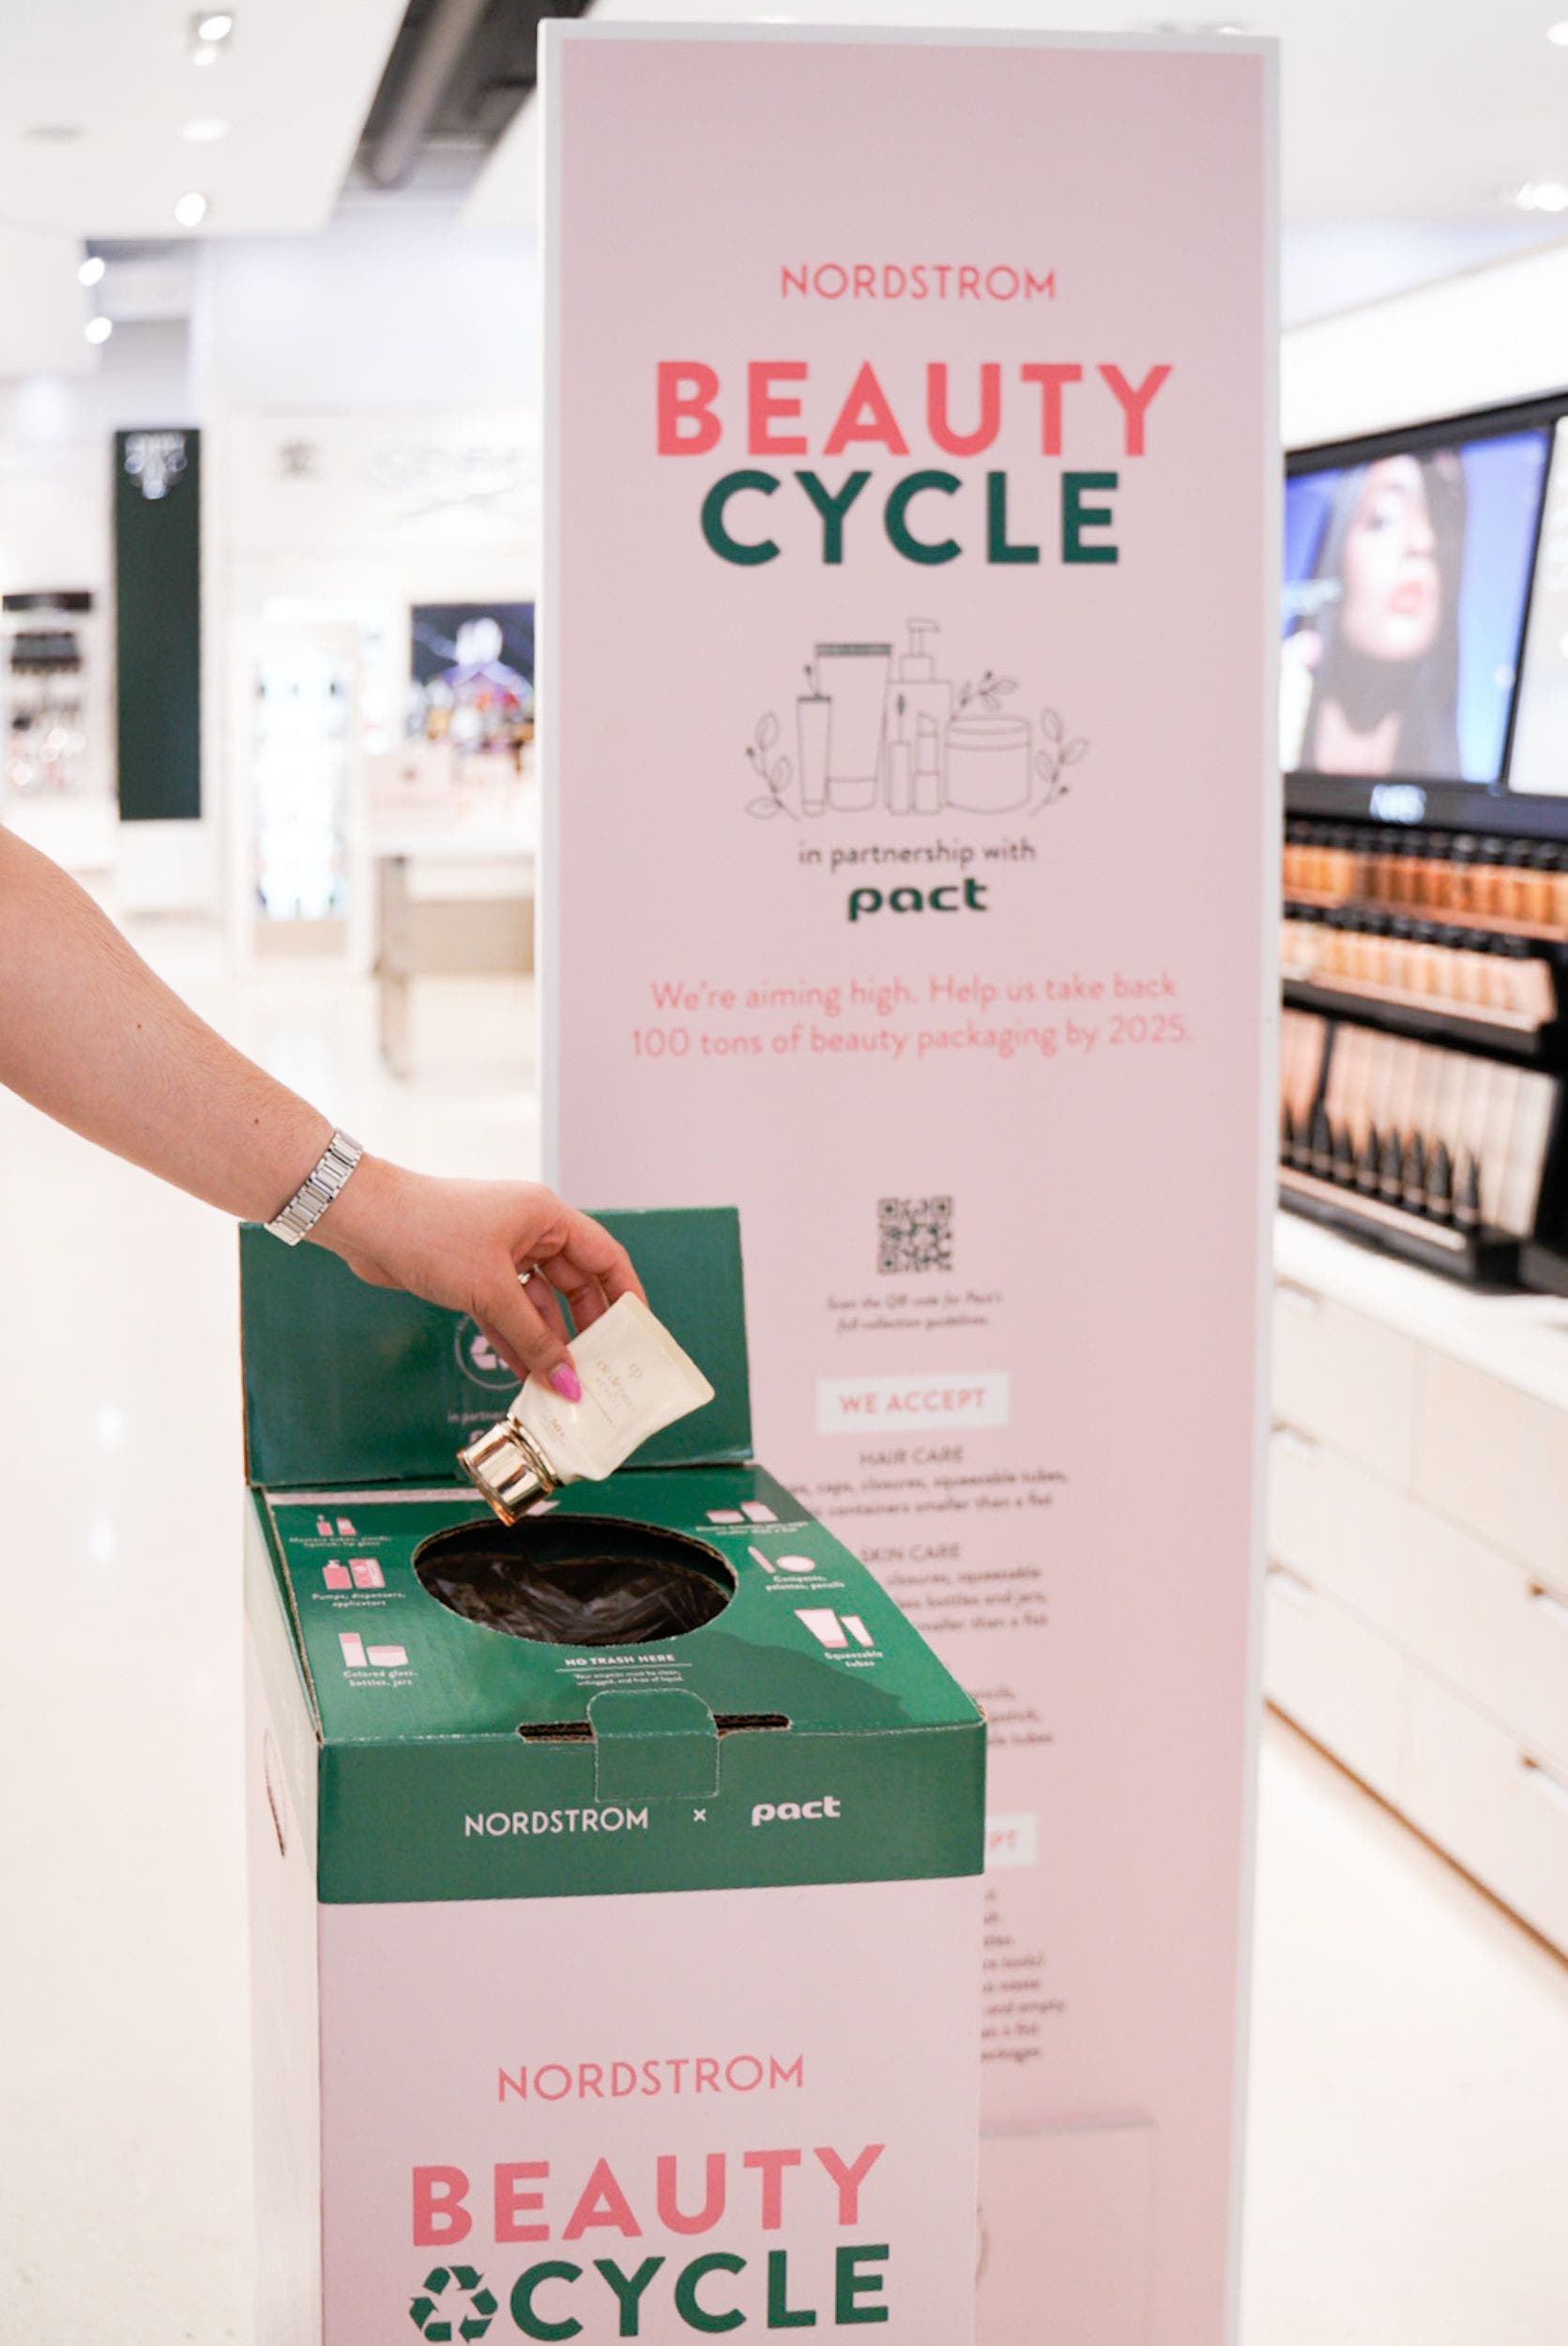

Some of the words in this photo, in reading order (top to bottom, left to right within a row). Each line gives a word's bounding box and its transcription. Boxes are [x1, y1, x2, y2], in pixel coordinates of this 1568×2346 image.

[782, 264, 1057, 300] NORDSTROM
[657, 360, 1175, 458] BEAUTY
[700, 469, 1119, 567] CYCLE
[799, 845, 822, 866] in
[830, 840, 976, 873] partnership
[983, 838, 1037, 861] with
[847, 877, 989, 922] pact
[651, 981, 736, 1013] We're
[746, 979, 842, 1017] aiming
[850, 976, 919, 1016] high.
[929, 976, 997, 1012] Help
[1006, 983, 1035, 1003] us
[1044, 971, 1105, 1001] take
[1114, 970, 1177, 999] back
[632, 1028, 691, 1059] 100
[700, 1029, 763, 1058] tons
[772, 1025, 802, 1054] of
[811, 1024, 909, 1060] beauty
[918, 1019, 1058, 1060] packaging
[1065, 1019, 1099, 1055] by
[1109, 1013, 1193, 1045] 2025.
[839, 1392, 878, 1415] WE
[885, 1388, 987, 1413] ACCEPT
[859, 1448, 906, 1467] HAIR
[912, 1445, 964, 1465] CARE
[909, 1544, 961, 1561] CARE
[565, 1657, 588, 1667] NO
[589, 1654, 635, 1666] TRASH
[637, 1653, 676, 1663] HERE
[464, 1806, 648, 1837] NORDSTROM
[751, 1795, 842, 1828] pact
[497, 2053, 805, 2102] NORDSTROM
[412, 2143, 886, 2247] BEAUTY
[509, 2243, 891, 2343] CYCLE
